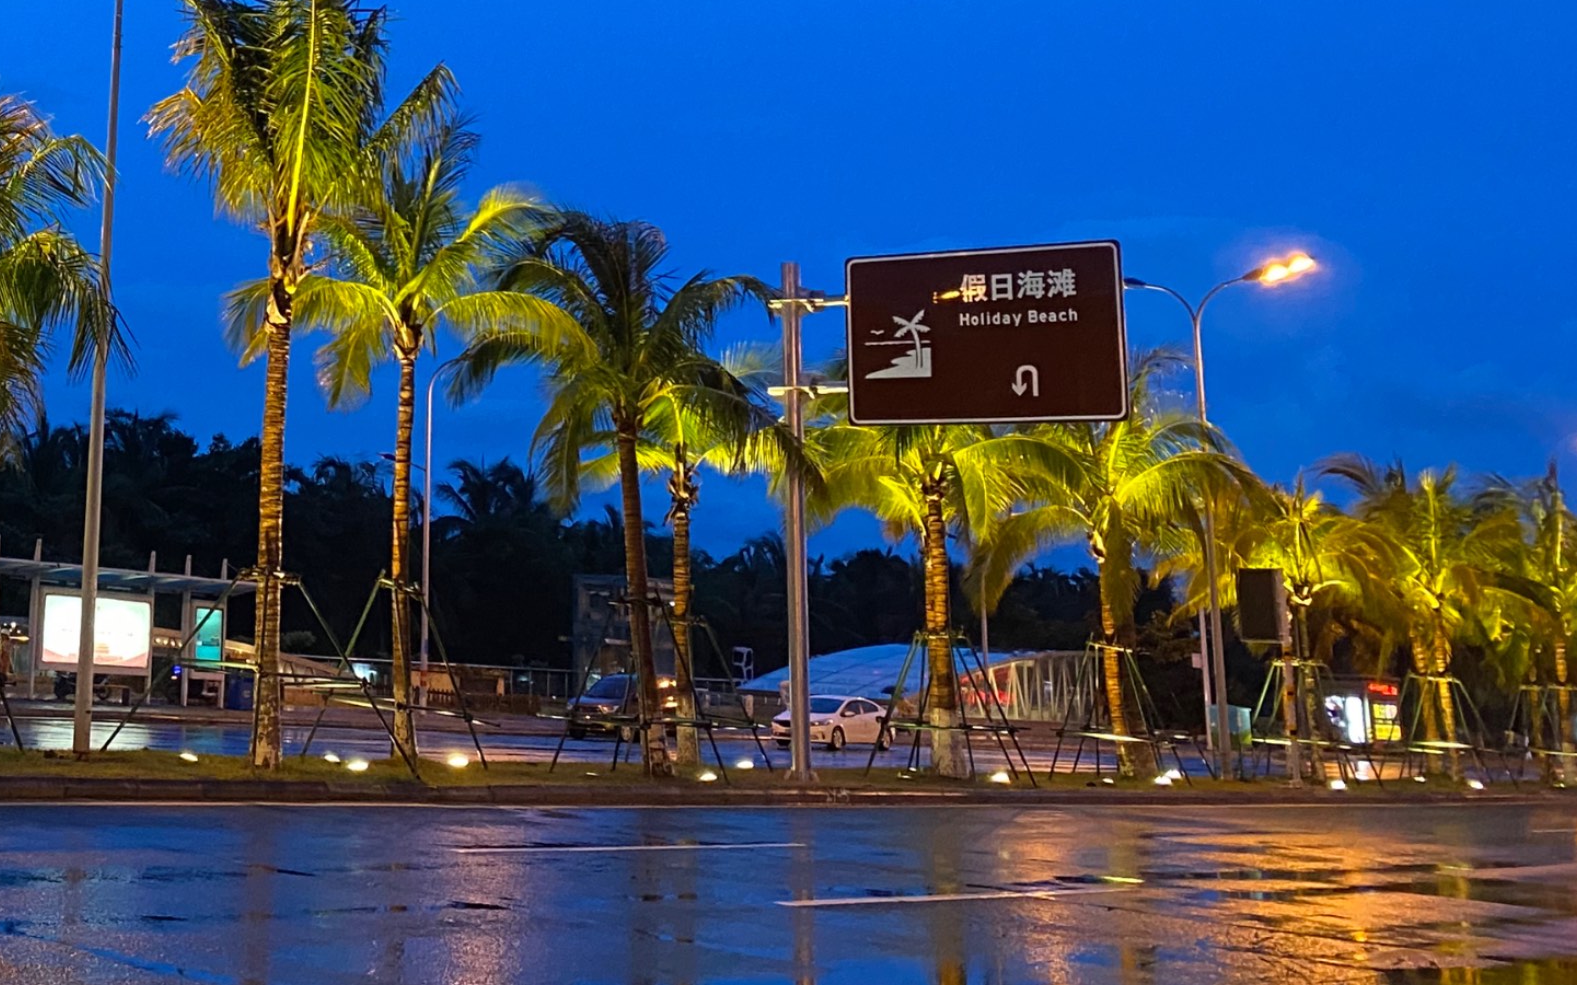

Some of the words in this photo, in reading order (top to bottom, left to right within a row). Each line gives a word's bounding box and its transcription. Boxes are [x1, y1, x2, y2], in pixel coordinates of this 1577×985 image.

[960, 269, 1076, 302] 假日海滩
[959, 311, 1022, 327] Holiday
[1027, 308, 1078, 323] Beach
